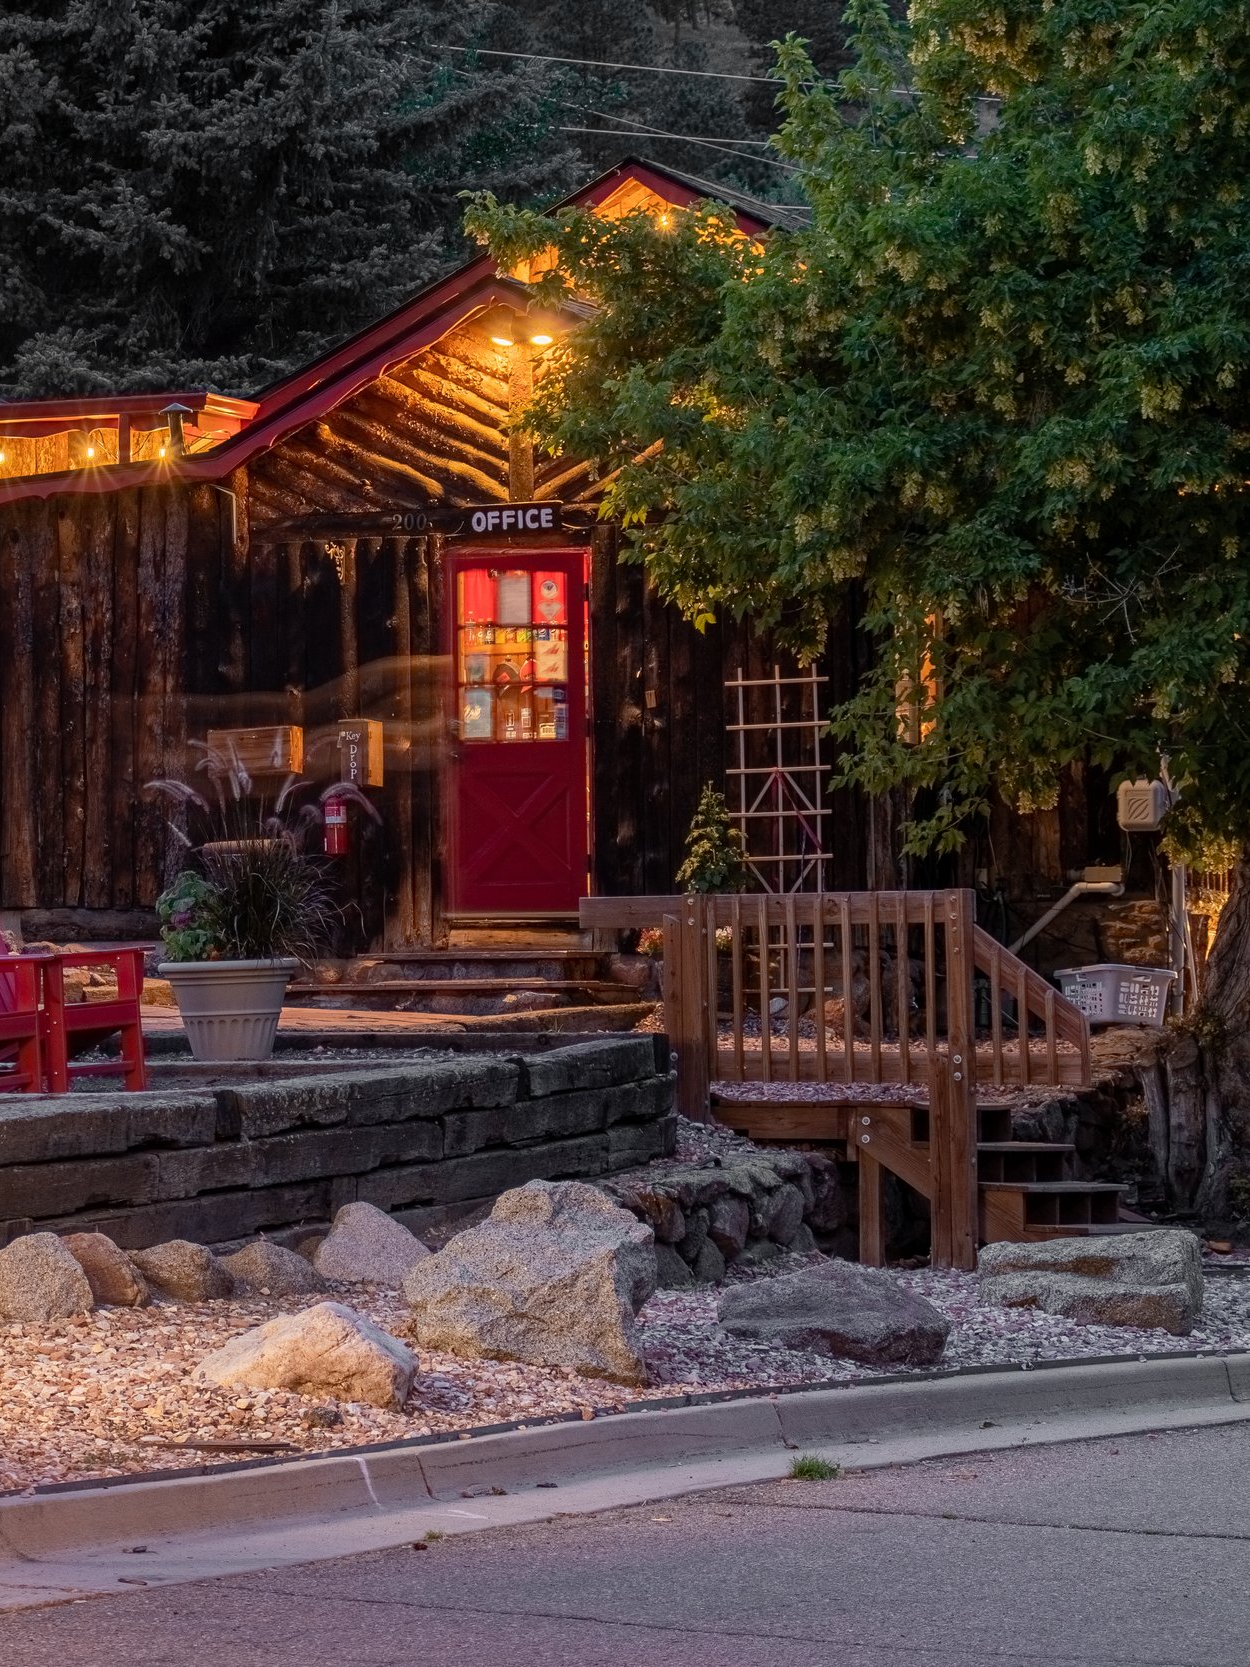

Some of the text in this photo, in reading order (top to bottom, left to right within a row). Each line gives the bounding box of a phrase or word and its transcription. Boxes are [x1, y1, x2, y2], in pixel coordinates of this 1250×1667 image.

[391, 513, 428, 532] 200
[471, 508, 554, 533] OFFICE
[345, 730, 362, 743] Key
